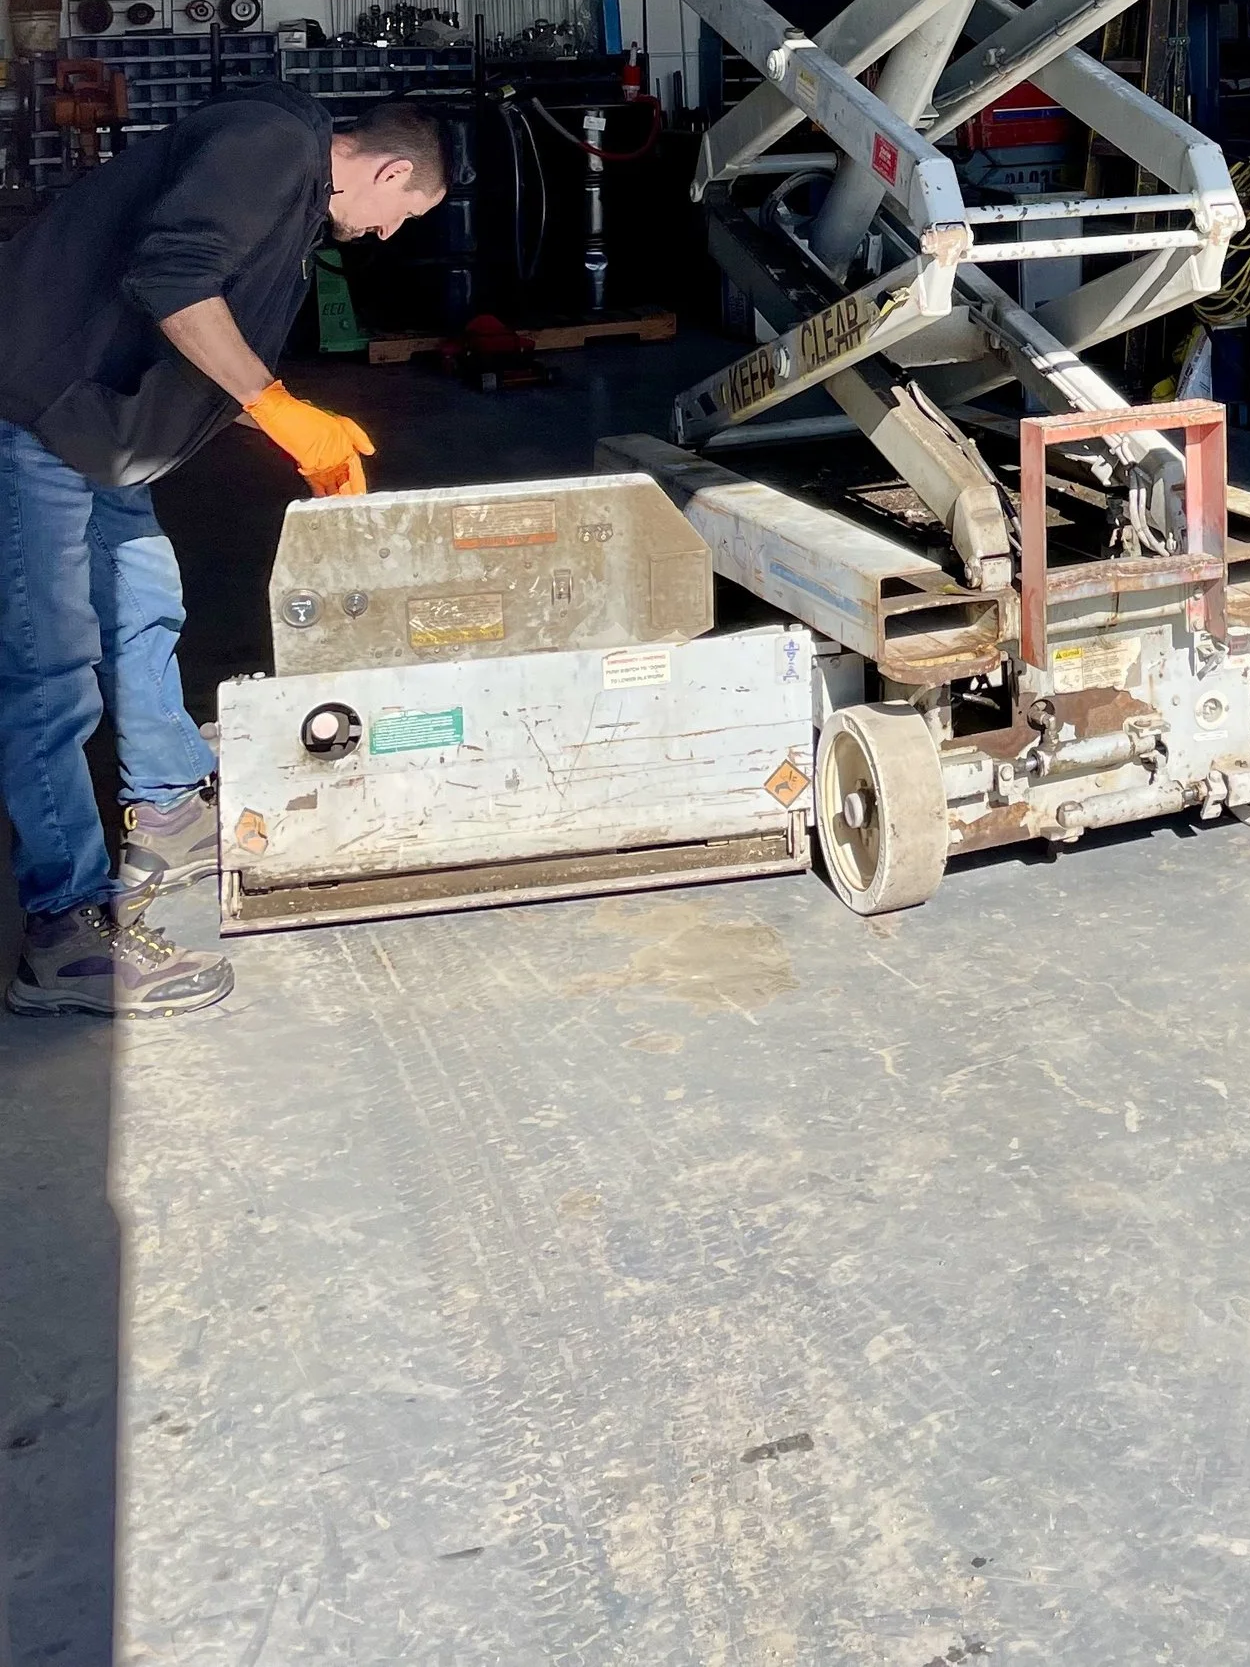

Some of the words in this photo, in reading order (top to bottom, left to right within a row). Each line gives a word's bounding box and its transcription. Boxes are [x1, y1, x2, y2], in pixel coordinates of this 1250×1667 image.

[321, 302, 346, 316] ECO
[729, 348, 773, 414] KEEP
[800, 296, 865, 368] CLEAR
